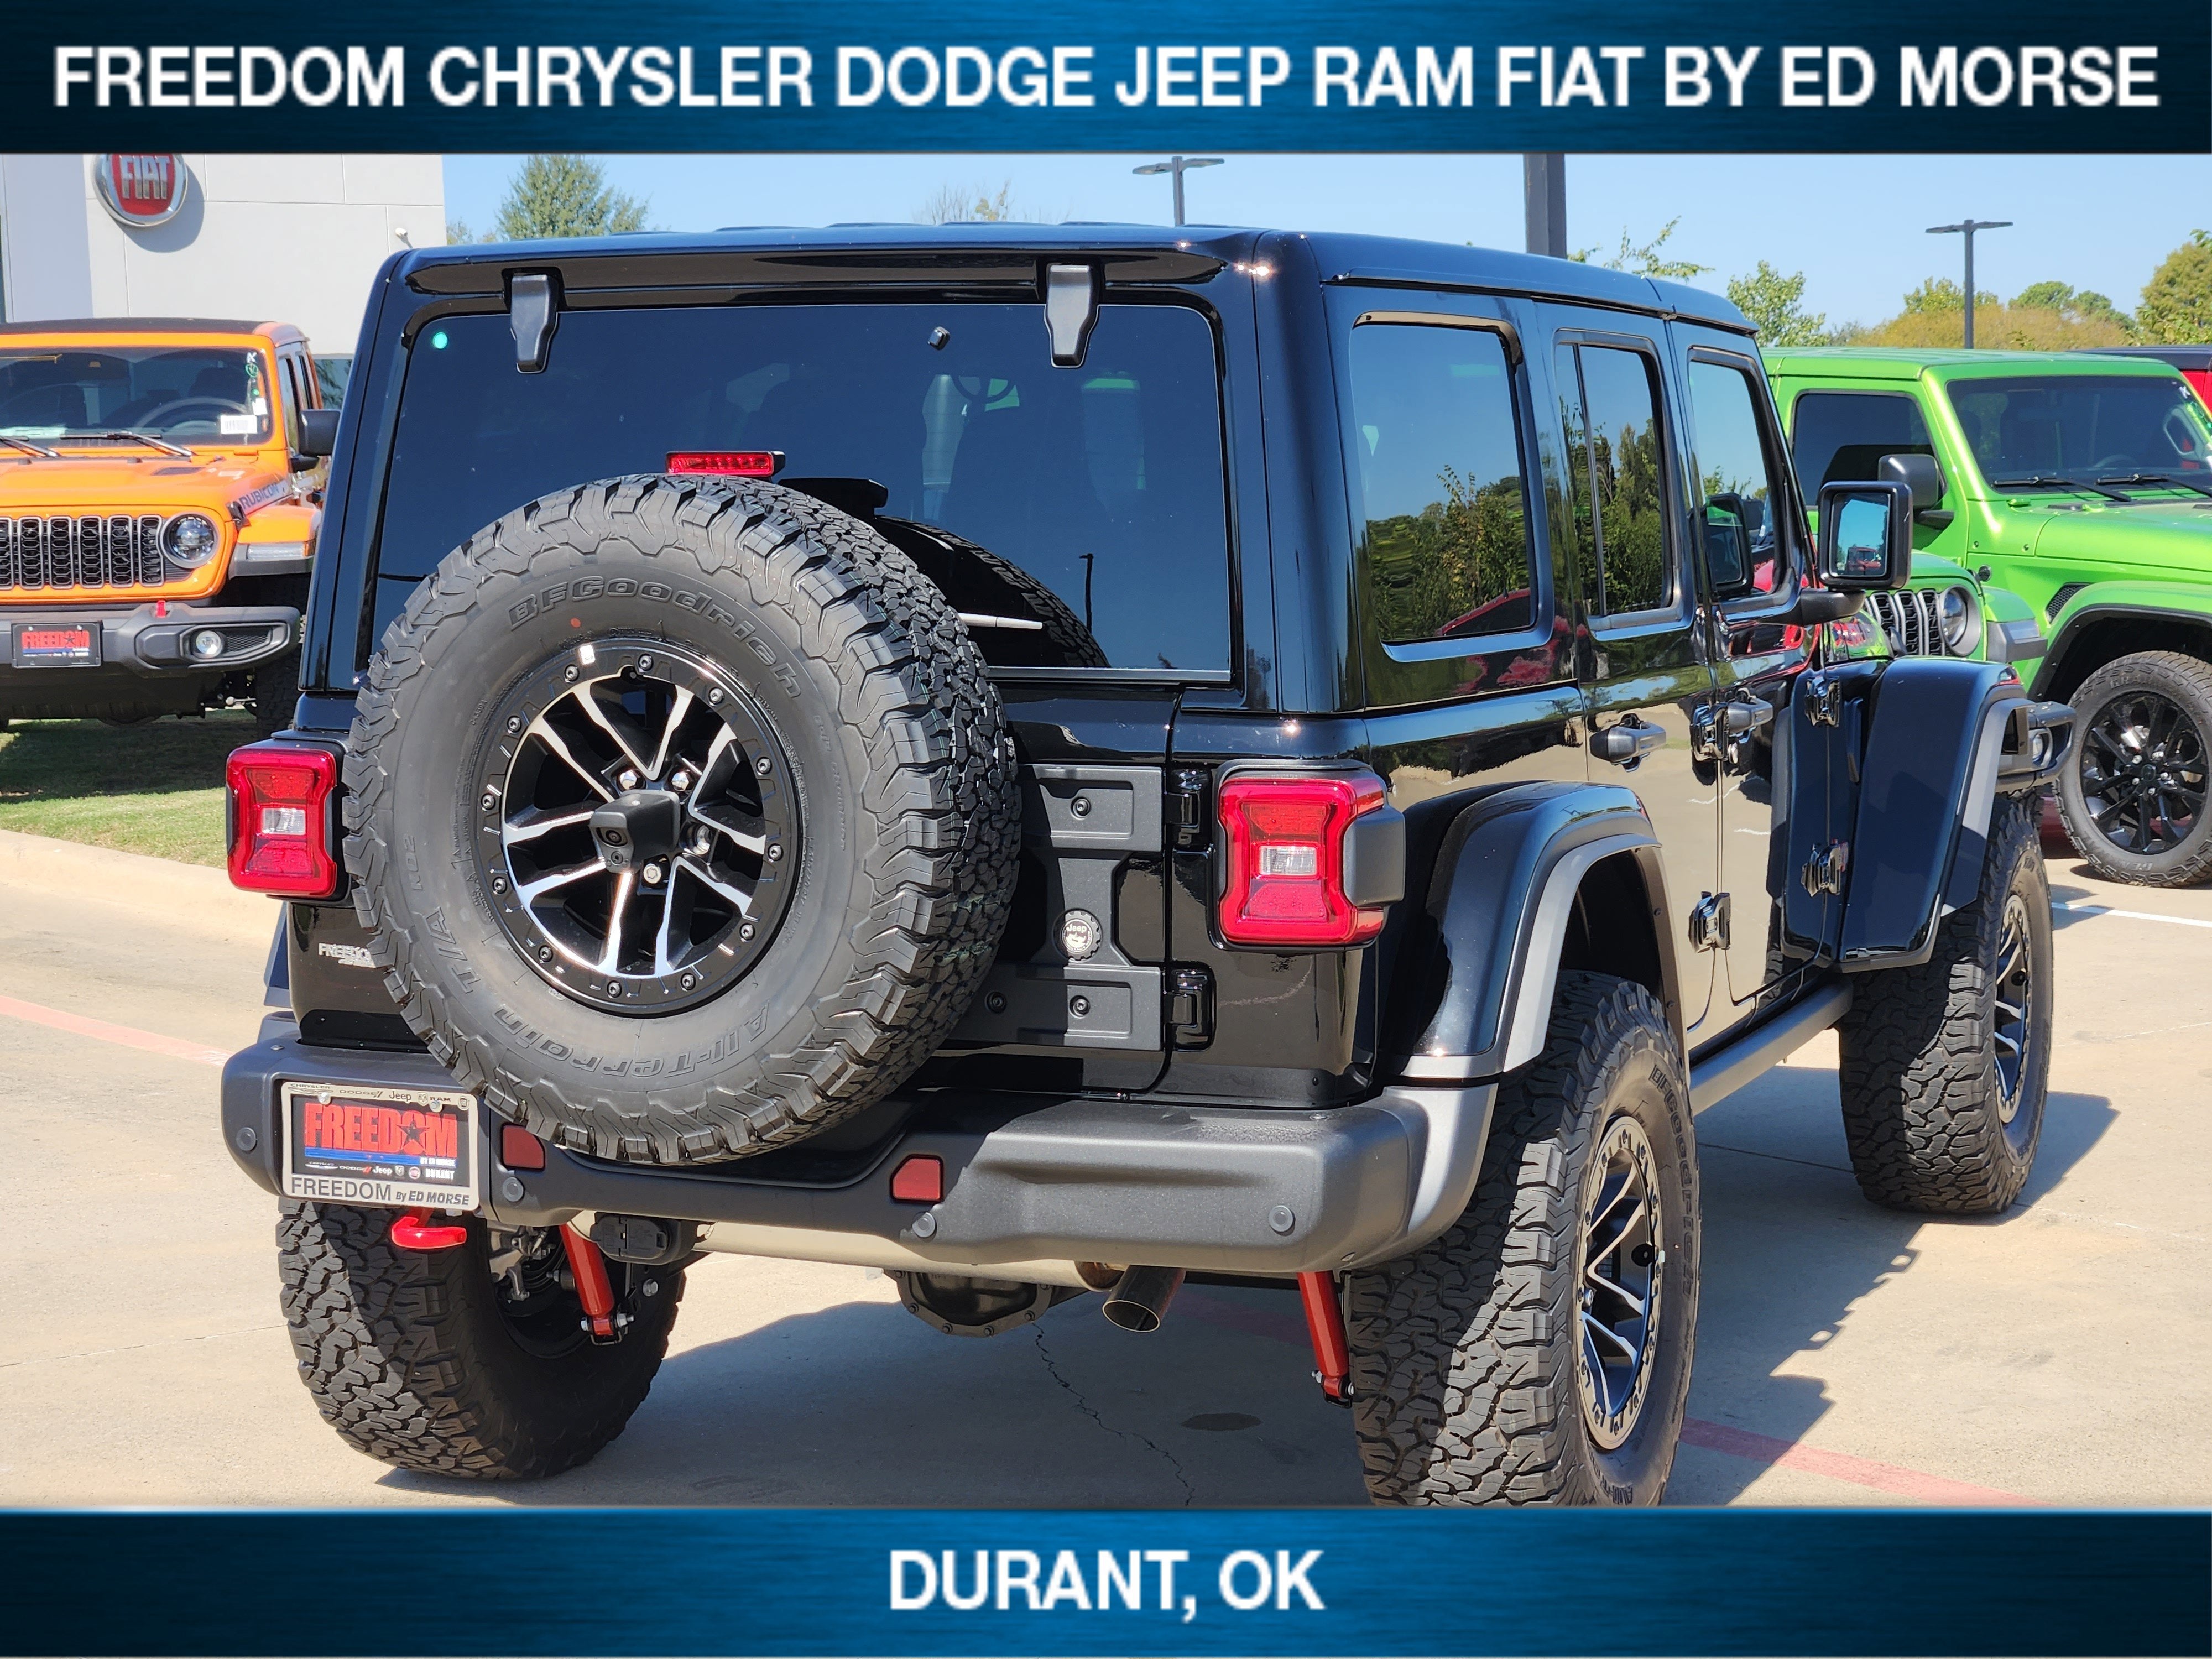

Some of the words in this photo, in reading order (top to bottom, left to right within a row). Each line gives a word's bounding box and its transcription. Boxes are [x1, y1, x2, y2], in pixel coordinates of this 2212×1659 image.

[119, 155, 170, 200] FIAT
[239, 482, 279, 510] RUBICON
[22, 630, 90, 649] FREEDOM
[508, 576, 804, 699] BFGoodrich
[1066, 924, 1087, 933] Jeep
[389, 1091, 411, 1102] Jeep
[304, 1102, 458, 1158] FREEDOM
[372, 1165, 393, 1176] Jeep
[1649, 1065, 1695, 1296] BFGoodrich
[291, 1177, 392, 1201] FREEDOM
[408, 1190, 424, 1202] ED
[426, 1192, 470, 1206] MORSE
